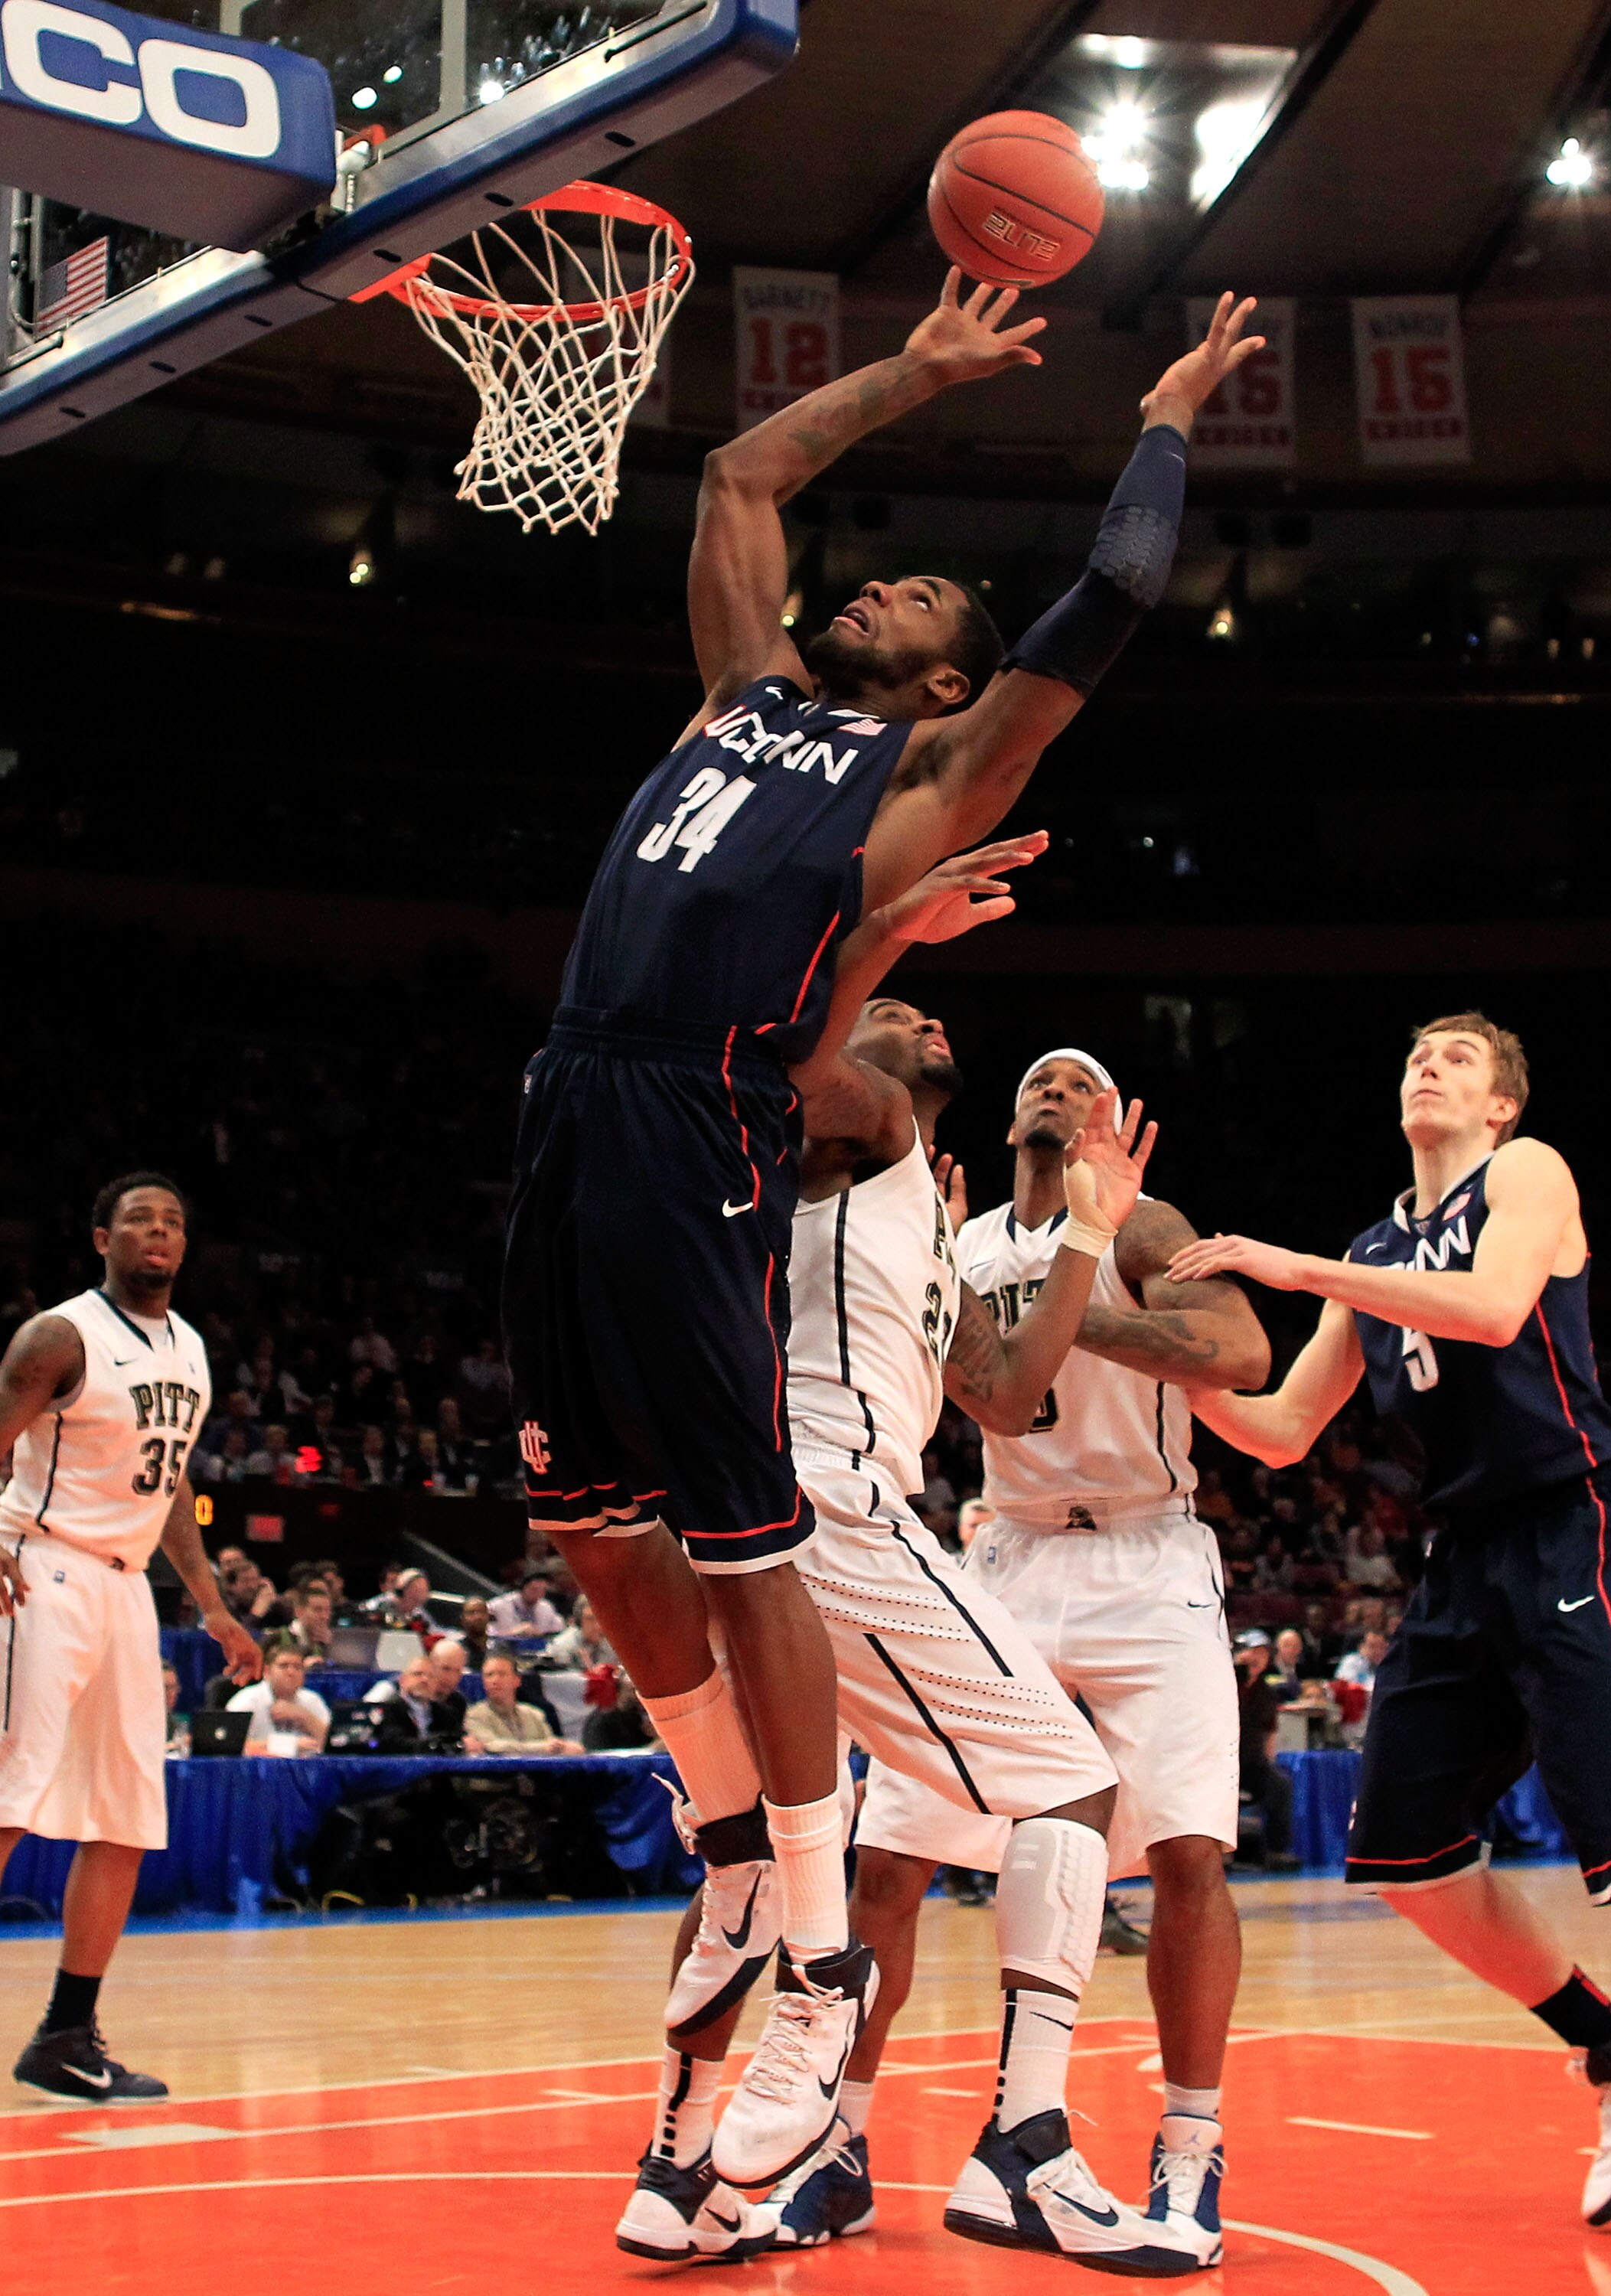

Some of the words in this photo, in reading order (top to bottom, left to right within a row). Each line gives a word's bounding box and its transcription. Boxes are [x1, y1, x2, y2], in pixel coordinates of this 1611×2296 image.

[0, 0, 281, 158] CO
[983, 212, 1061, 261] ELITE
[750, 318, 829, 386] 12
[703, 705, 859, 785] UCONN
[636, 767, 758, 873] 34
[1403, 1325, 1440, 1392] 5
[129, 1381, 201, 1434] PITT
[131, 1437, 188, 1498] 35
